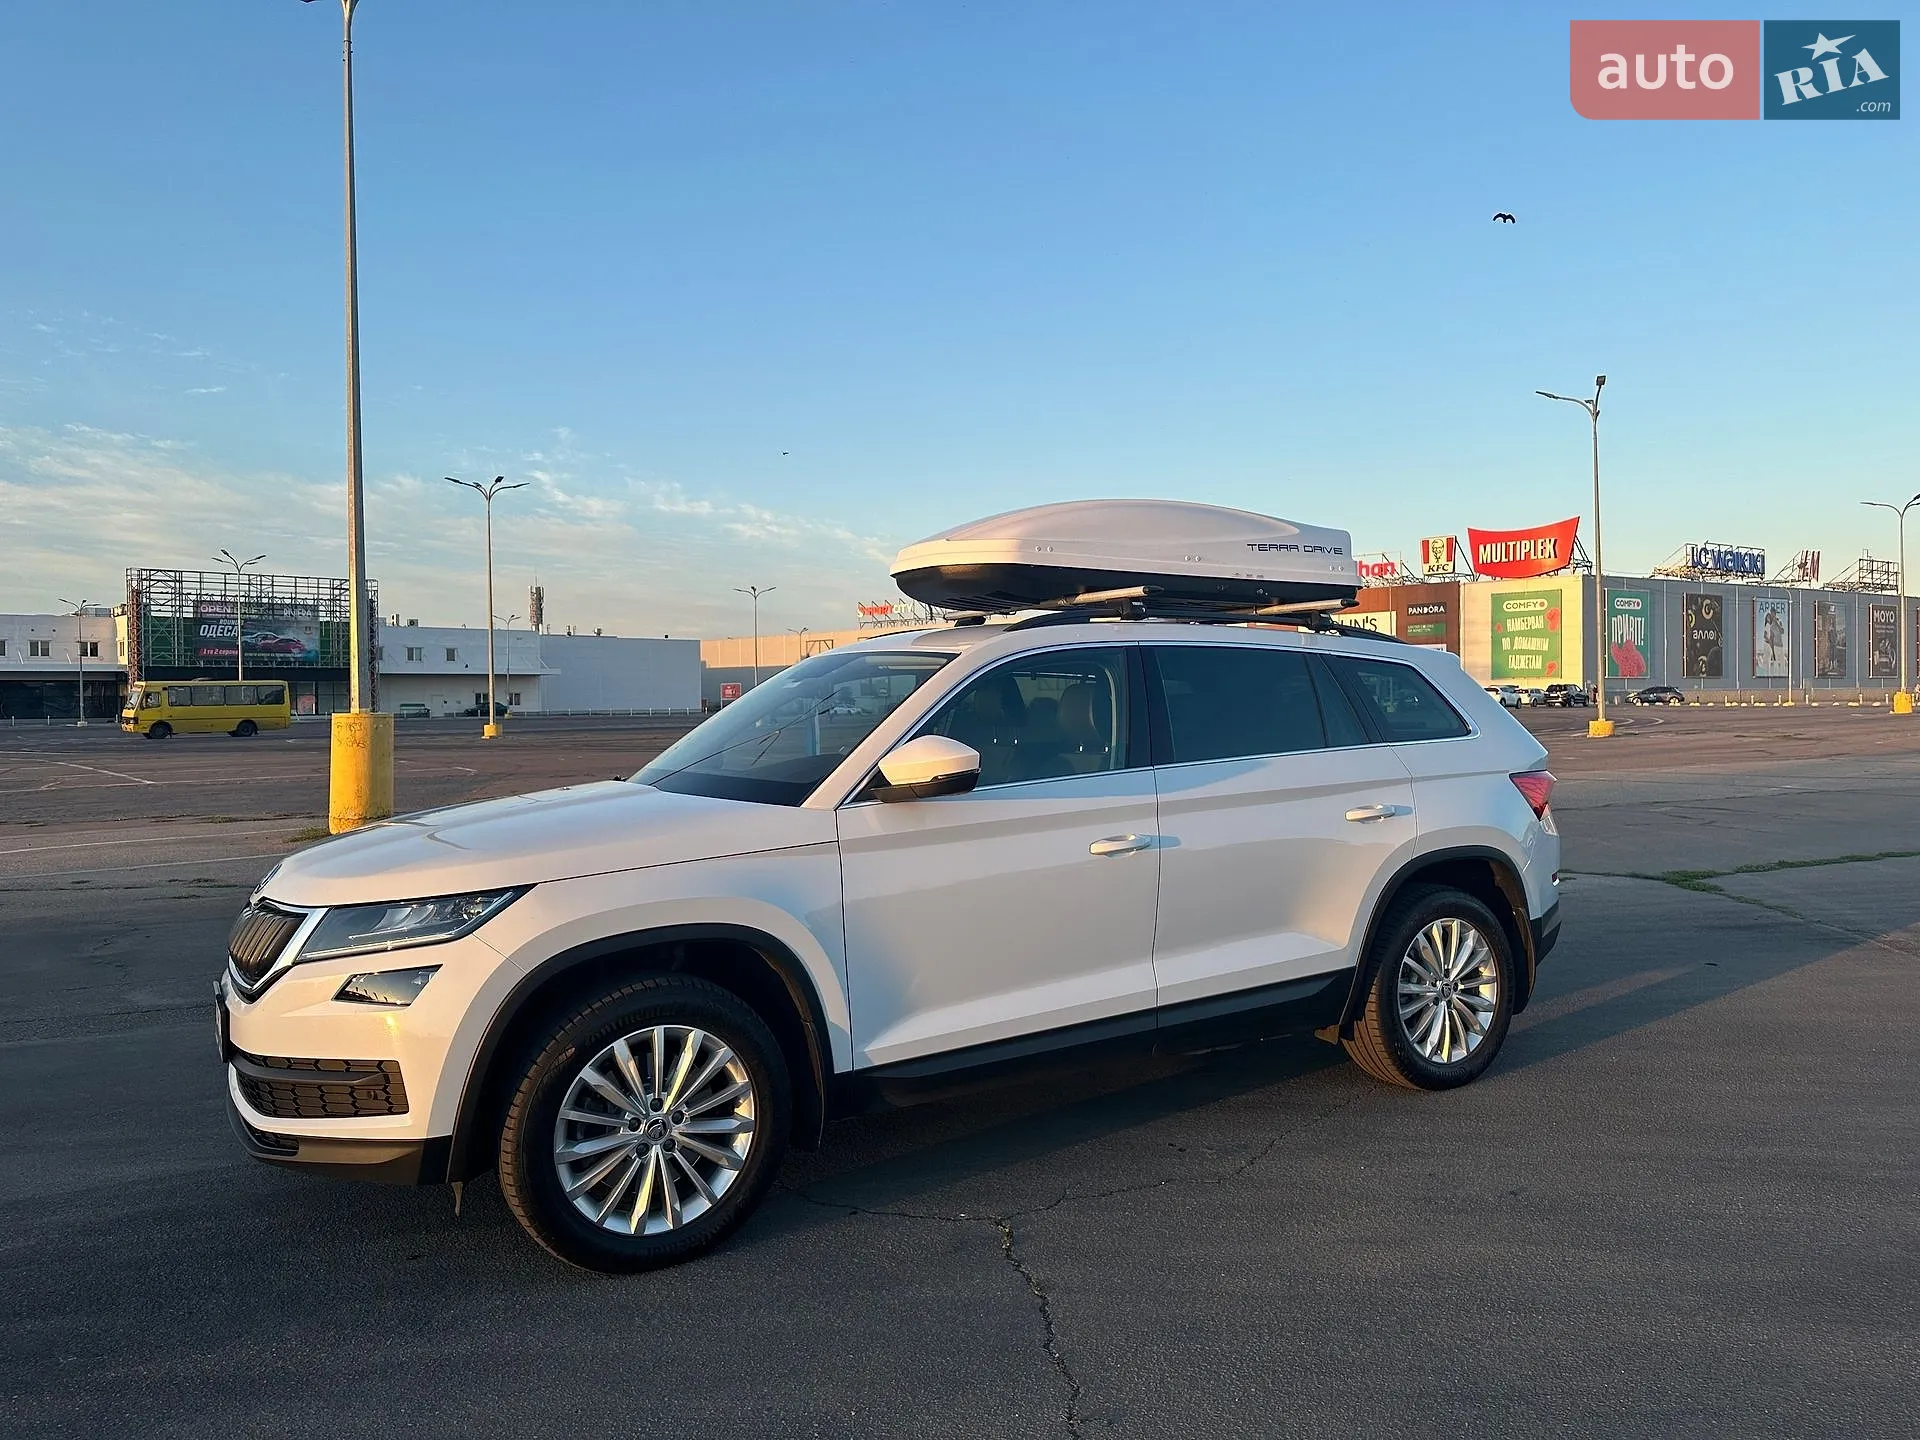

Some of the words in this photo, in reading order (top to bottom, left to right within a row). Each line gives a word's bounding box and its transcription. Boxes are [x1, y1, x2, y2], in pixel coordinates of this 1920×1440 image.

[1246, 543, 1300, 552] TERRA
[1303, 545, 1344, 555] DRIVE
[1478, 537, 1558, 565] MULTIPLEX
[1427, 563, 1450, 573] KFC
[200, 604, 231, 613] OPEN
[1505, 601, 1539, 609] COMFY
[1615, 599, 1636, 608] COMFY
[1408, 605, 1446, 615] PANDORA
[1873, 610, 1895, 623] MOYO
[200, 624, 238, 638] ОДЕСА
